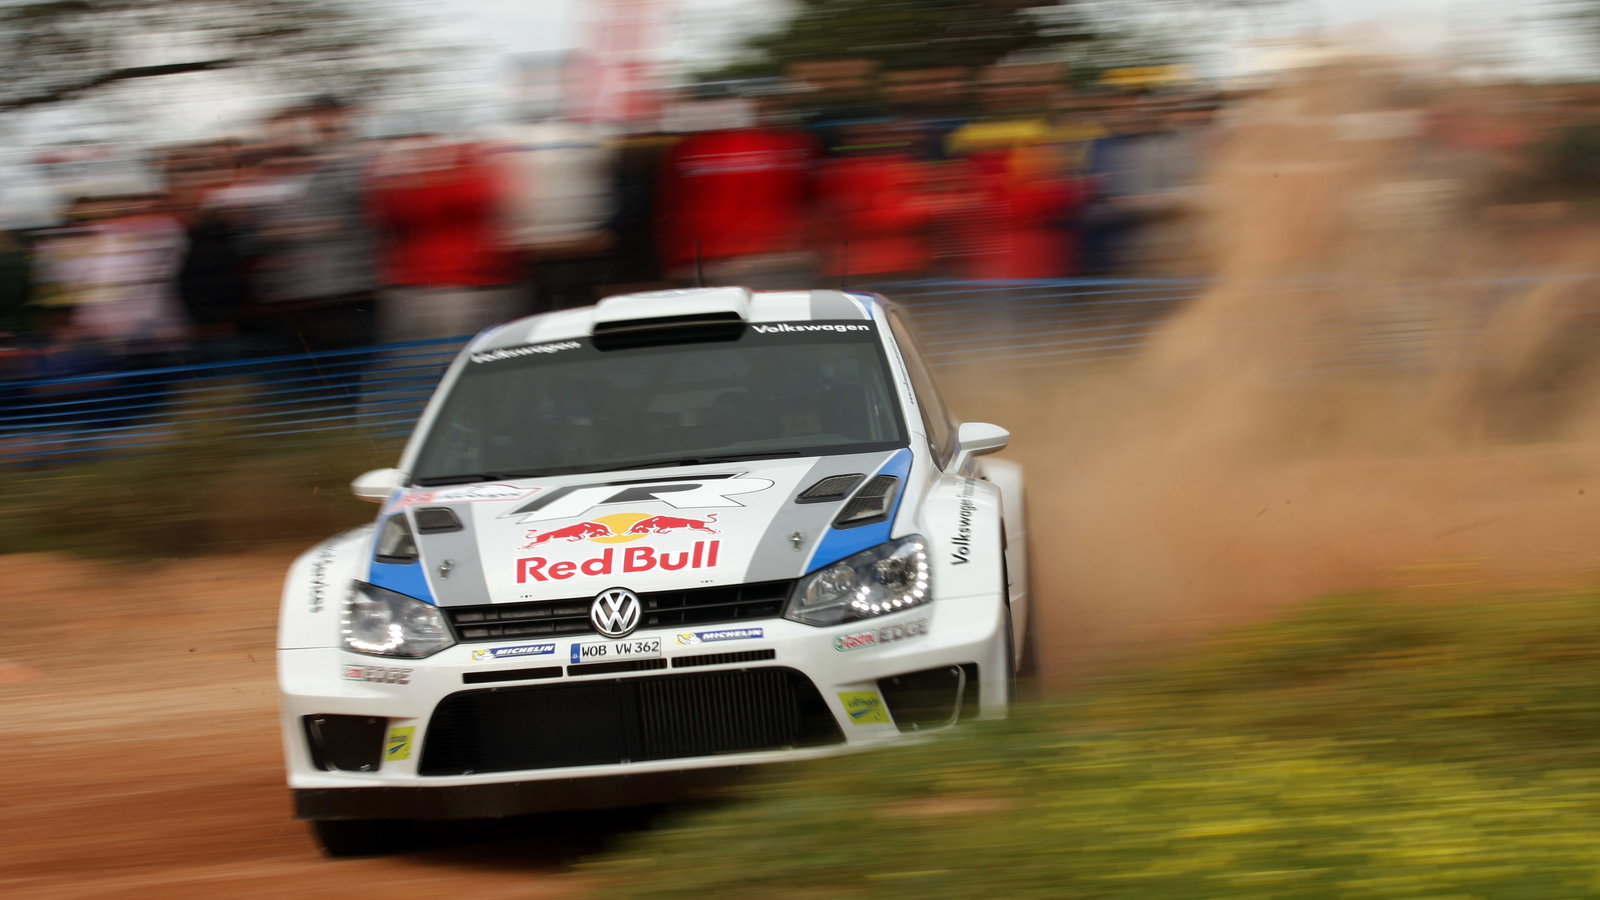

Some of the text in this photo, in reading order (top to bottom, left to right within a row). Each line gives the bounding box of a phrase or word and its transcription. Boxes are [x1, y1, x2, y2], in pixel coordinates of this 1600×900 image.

[752, 323, 870, 333] Volkswagen
[516, 540, 720, 584] Red Bull
[703, 629, 762, 640] MICHELIN
[879, 618, 929, 644] EDGE
[496, 645, 554, 656] MICHELIN
[582, 645, 607, 658] WOB
[615, 643, 632, 655] VW
[634, 641, 660, 653] 362
